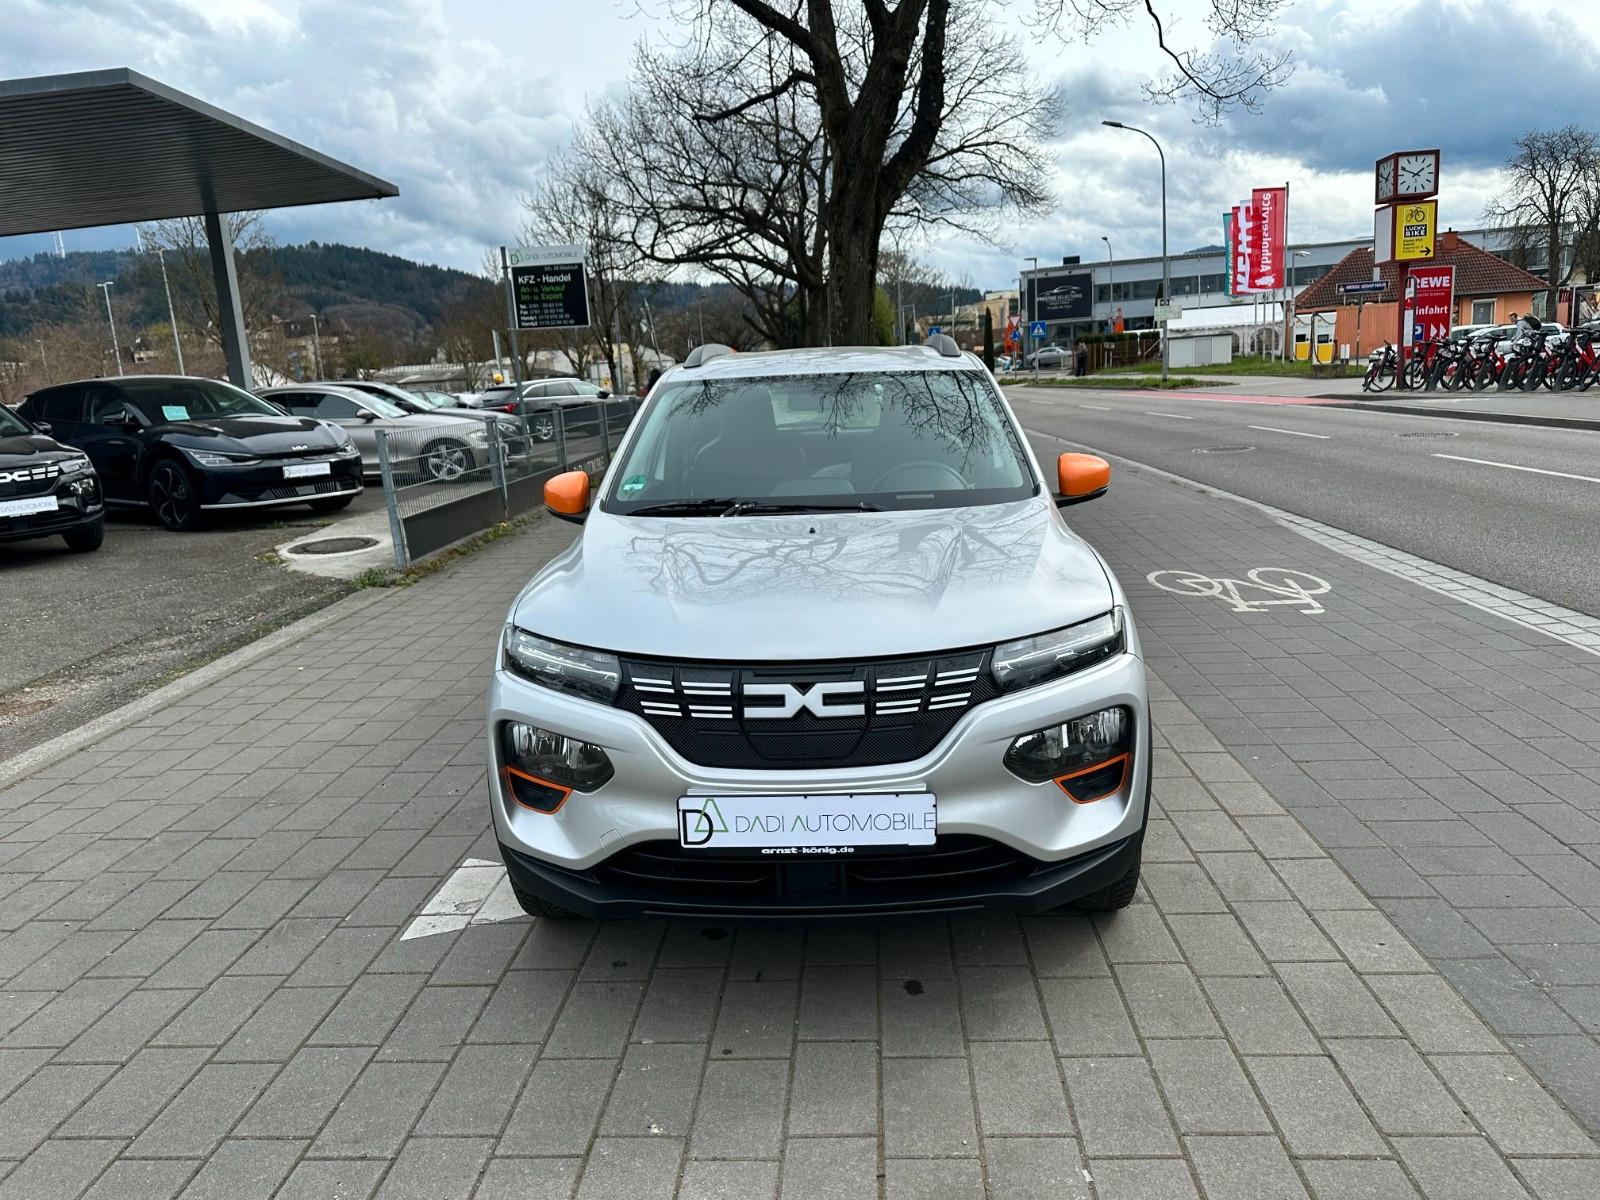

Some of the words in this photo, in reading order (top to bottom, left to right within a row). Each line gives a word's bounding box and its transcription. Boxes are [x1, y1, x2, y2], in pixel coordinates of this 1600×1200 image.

[518, 275, 535, 285] KFZ
[542, 273, 571, 283] Handel
[1412, 276, 1450, 289] REWE
[1416, 305, 1448, 315] infahrt
[735, 814, 785, 833] DADI
[790, 811, 936, 833] AUTOMOBILE
[761, 846, 855, 855] ernst-könig.de
